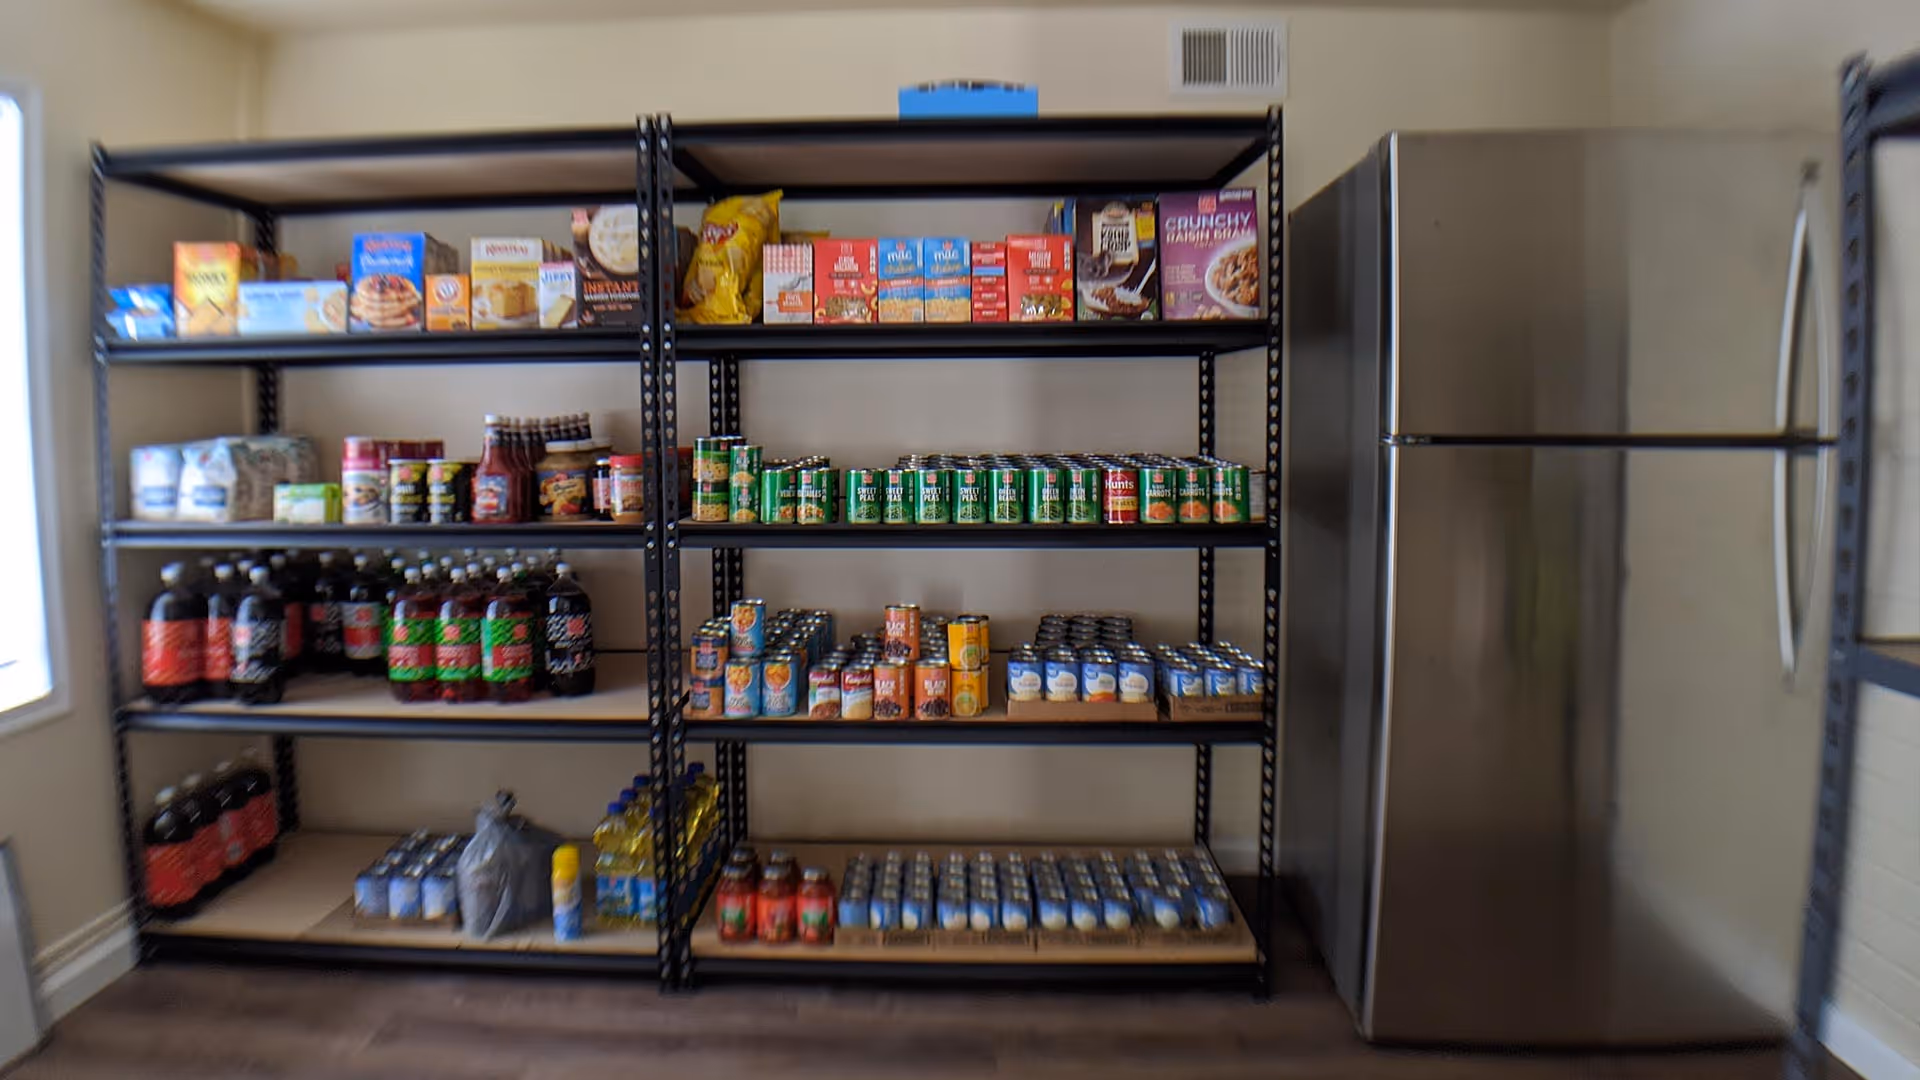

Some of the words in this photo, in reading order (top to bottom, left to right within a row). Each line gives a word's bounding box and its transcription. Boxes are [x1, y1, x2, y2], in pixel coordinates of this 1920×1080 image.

[1165, 211, 1252, 232] CRUNCHY
[1166, 229, 1210, 245] RAISIN
[1214, 227, 1252, 239] BRAN
[583, 281, 639, 293] INSTANT
[1146, 489, 1171, 497] CARROTS
[1179, 488, 1205, 496] CARROTS
[859, 494, 875, 502] PEAS
[886, 494, 902, 502] PEAS
[924, 494, 940, 502] PEAS
[962, 494, 978, 502] PEAS
[886, 621, 906, 630] BLACK
[875, 680, 896, 688] BLACK
[924, 680, 947, 688] BLACK
